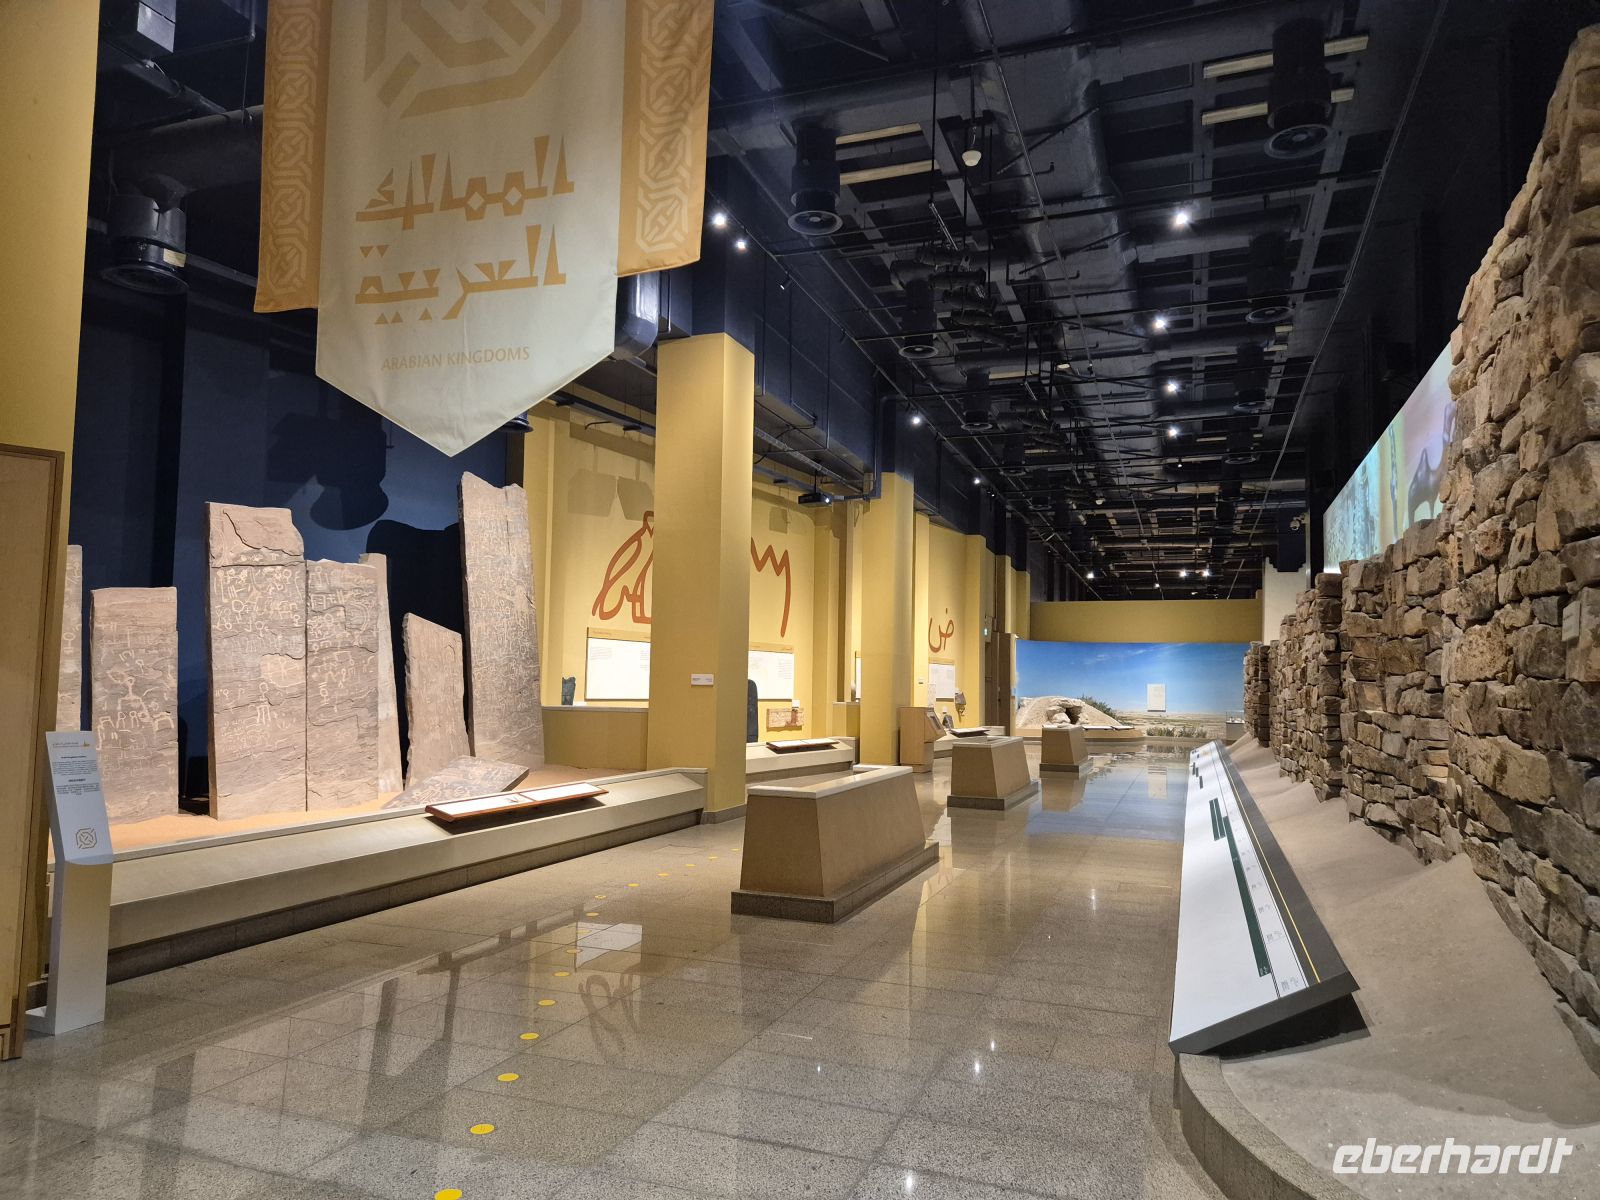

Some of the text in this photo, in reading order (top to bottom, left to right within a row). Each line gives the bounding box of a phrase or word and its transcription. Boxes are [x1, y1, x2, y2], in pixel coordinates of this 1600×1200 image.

[356, 135, 575, 231] الممالك
[355, 224, 566, 325] العربية
[382, 346, 530, 371] ARABIAN KINGDOMS
